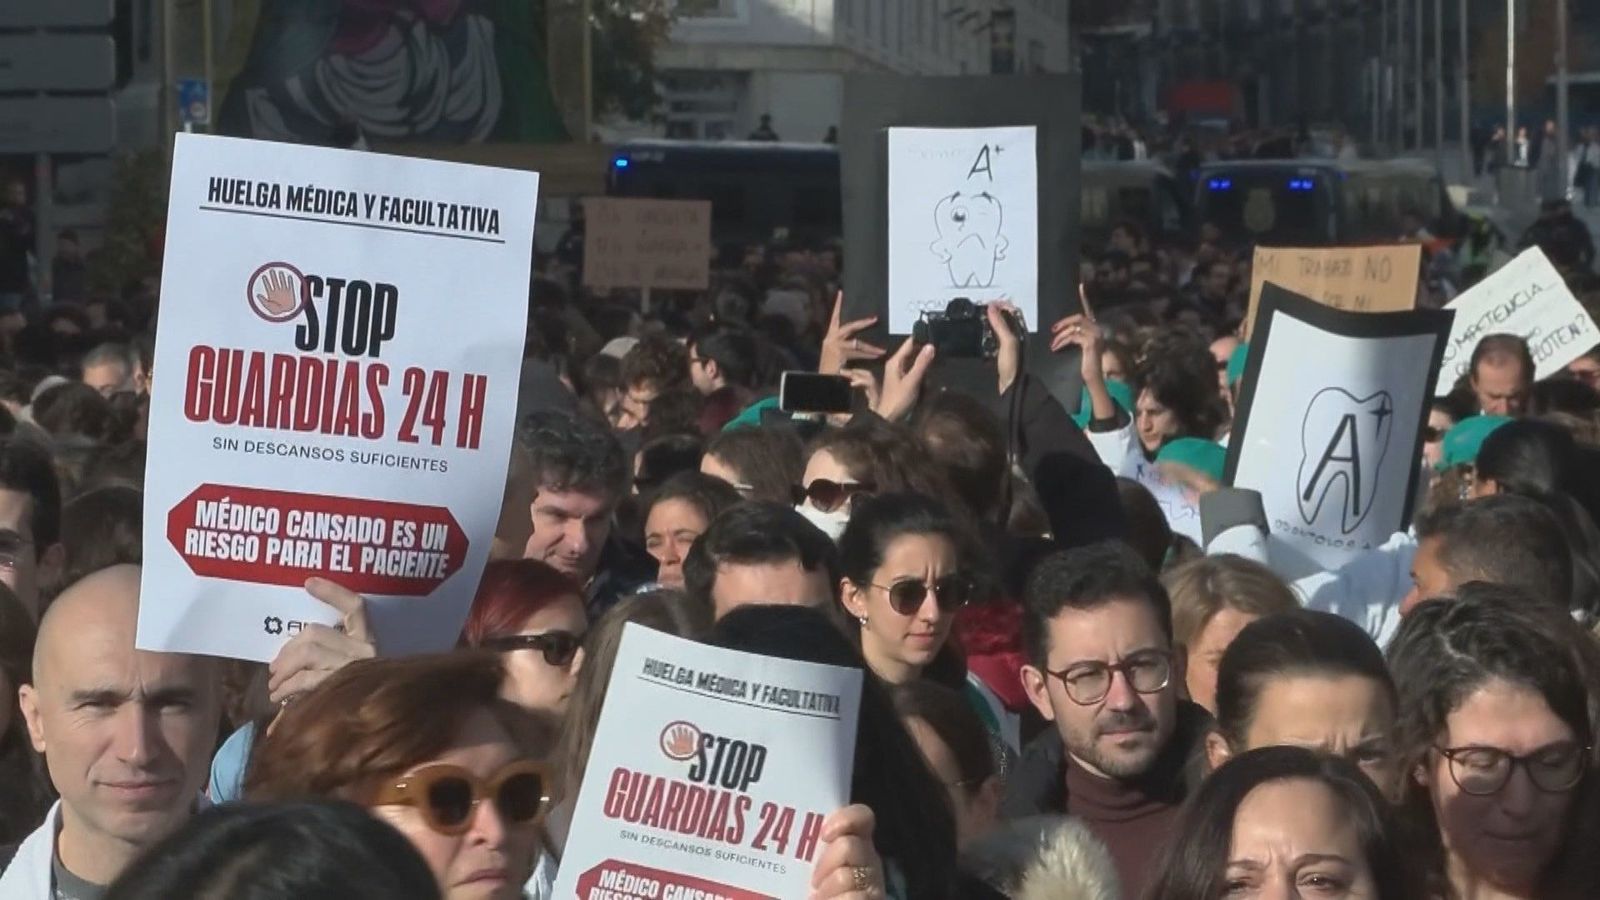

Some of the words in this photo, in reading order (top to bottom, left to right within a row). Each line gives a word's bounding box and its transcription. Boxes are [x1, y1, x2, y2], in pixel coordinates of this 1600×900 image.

[208, 176, 281, 209] HUELGA
[286, 184, 358, 218] MÉDICA
[363, 193, 377, 219] Y
[379, 195, 499, 235] FACULTATIVA
[1364, 255, 1392, 283] NO
[294, 274, 399, 358] STOP
[1441, 283, 1543, 367] OMPETENCIA
[184, 344, 390, 440] GUARDIAS
[397, 366, 450, 446] 24
[456, 373, 487, 450] H
[212, 436, 239, 451] SIN
[244, 440, 345, 462] DESCANSOS
[350, 451, 448, 473] SUFICIENTES
[195, 497, 280, 535] MÉDICO
[286, 510, 386, 546] CANSADO
[391, 519, 417, 548] ES
[420, 522, 448, 552] UN
[1275, 518, 1371, 551] ODONTOLOGA
[184, 528, 260, 563] RIESGO
[265, 536, 322, 570] PARA
[329, 544, 353, 572] EL
[359, 548, 450, 579] PACIENTE
[642, 657, 693, 687] HUELGA
[696, 671, 748, 698] MÉDICA
[751, 682, 763, 702] Y
[688, 732, 768, 793] STOP
[603, 767, 752, 845] GUARDIAS
[751, 801, 796, 855] 24
[795, 811, 825, 862] H
[620, 829, 639, 842] SIN
[641, 834, 712, 857] DESCANSOS
[714, 849, 787, 875] SUFICIENTES
[599, 868, 660, 898] MÉDICO
